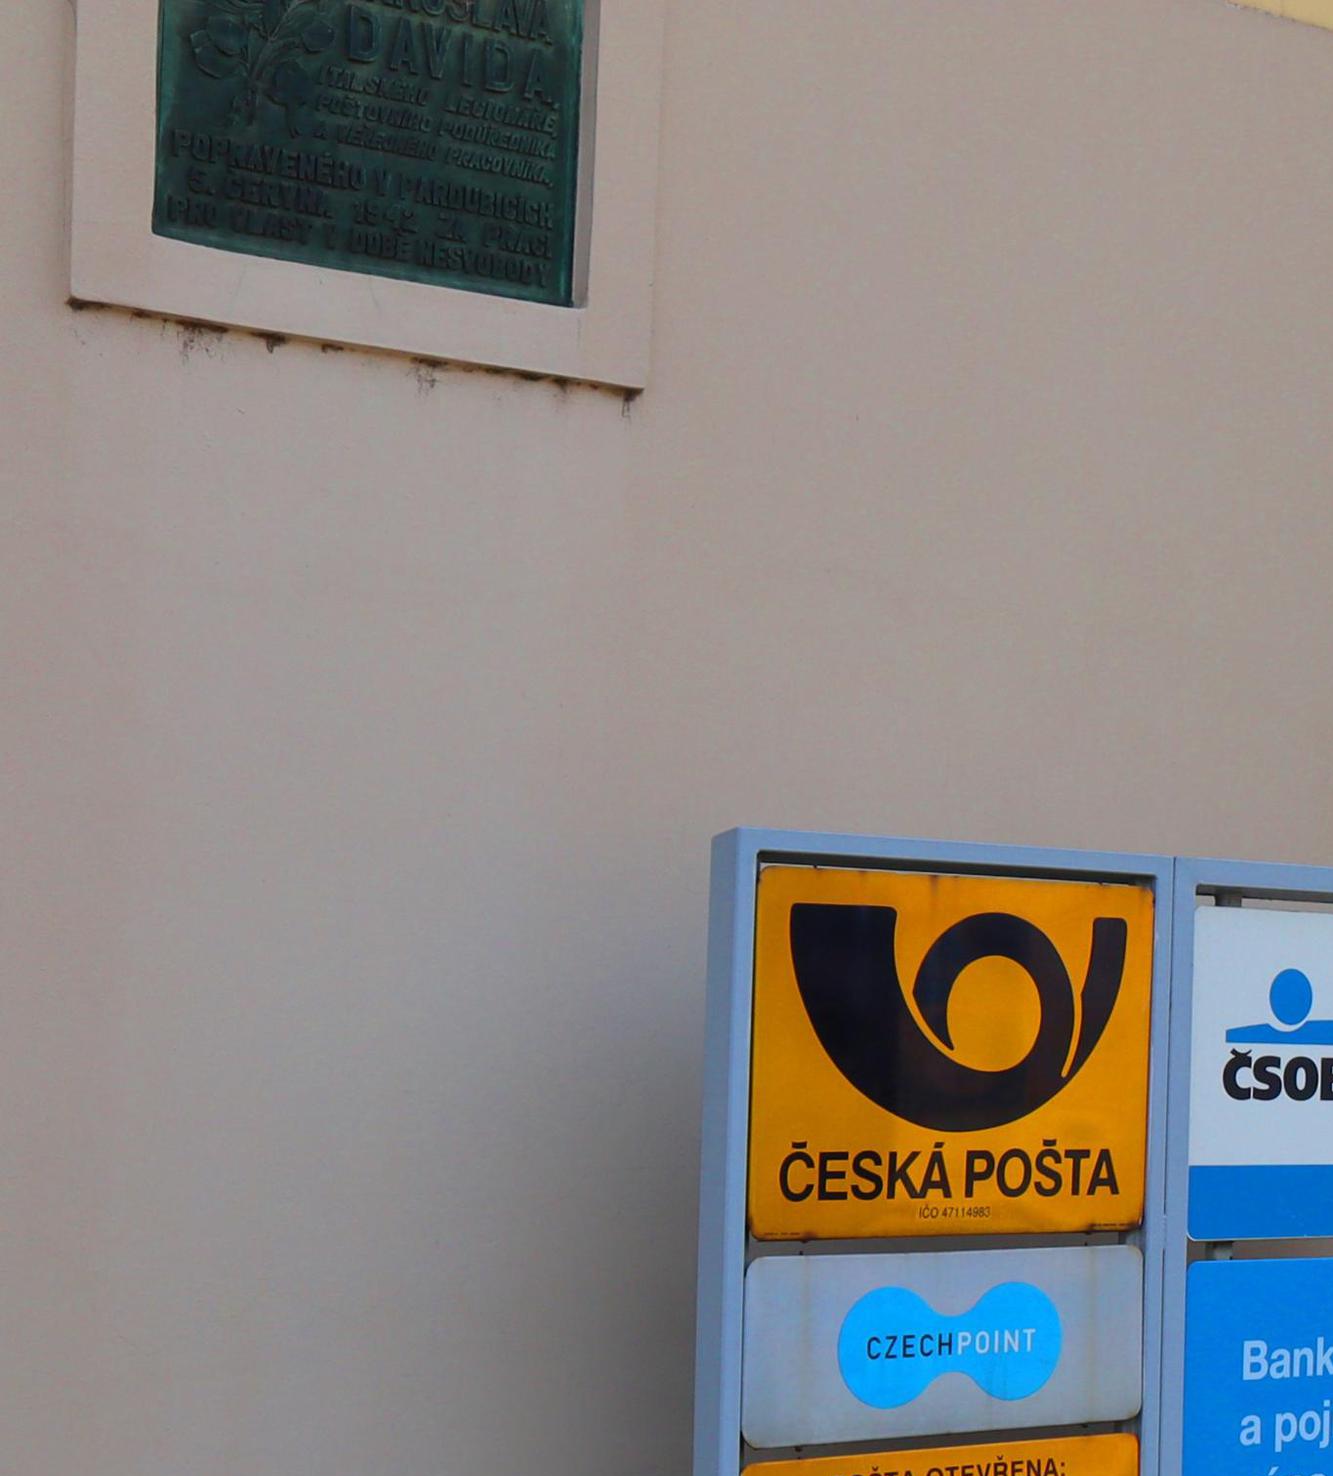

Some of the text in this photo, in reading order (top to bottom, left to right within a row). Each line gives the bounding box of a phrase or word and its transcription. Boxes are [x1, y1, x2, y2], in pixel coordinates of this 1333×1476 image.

[779, 1139, 1120, 1202] ČESKÁ POŠTA
[919, 1203, 992, 1219] IČO 47114983
[1239, 1414, 1261, 1446] a
